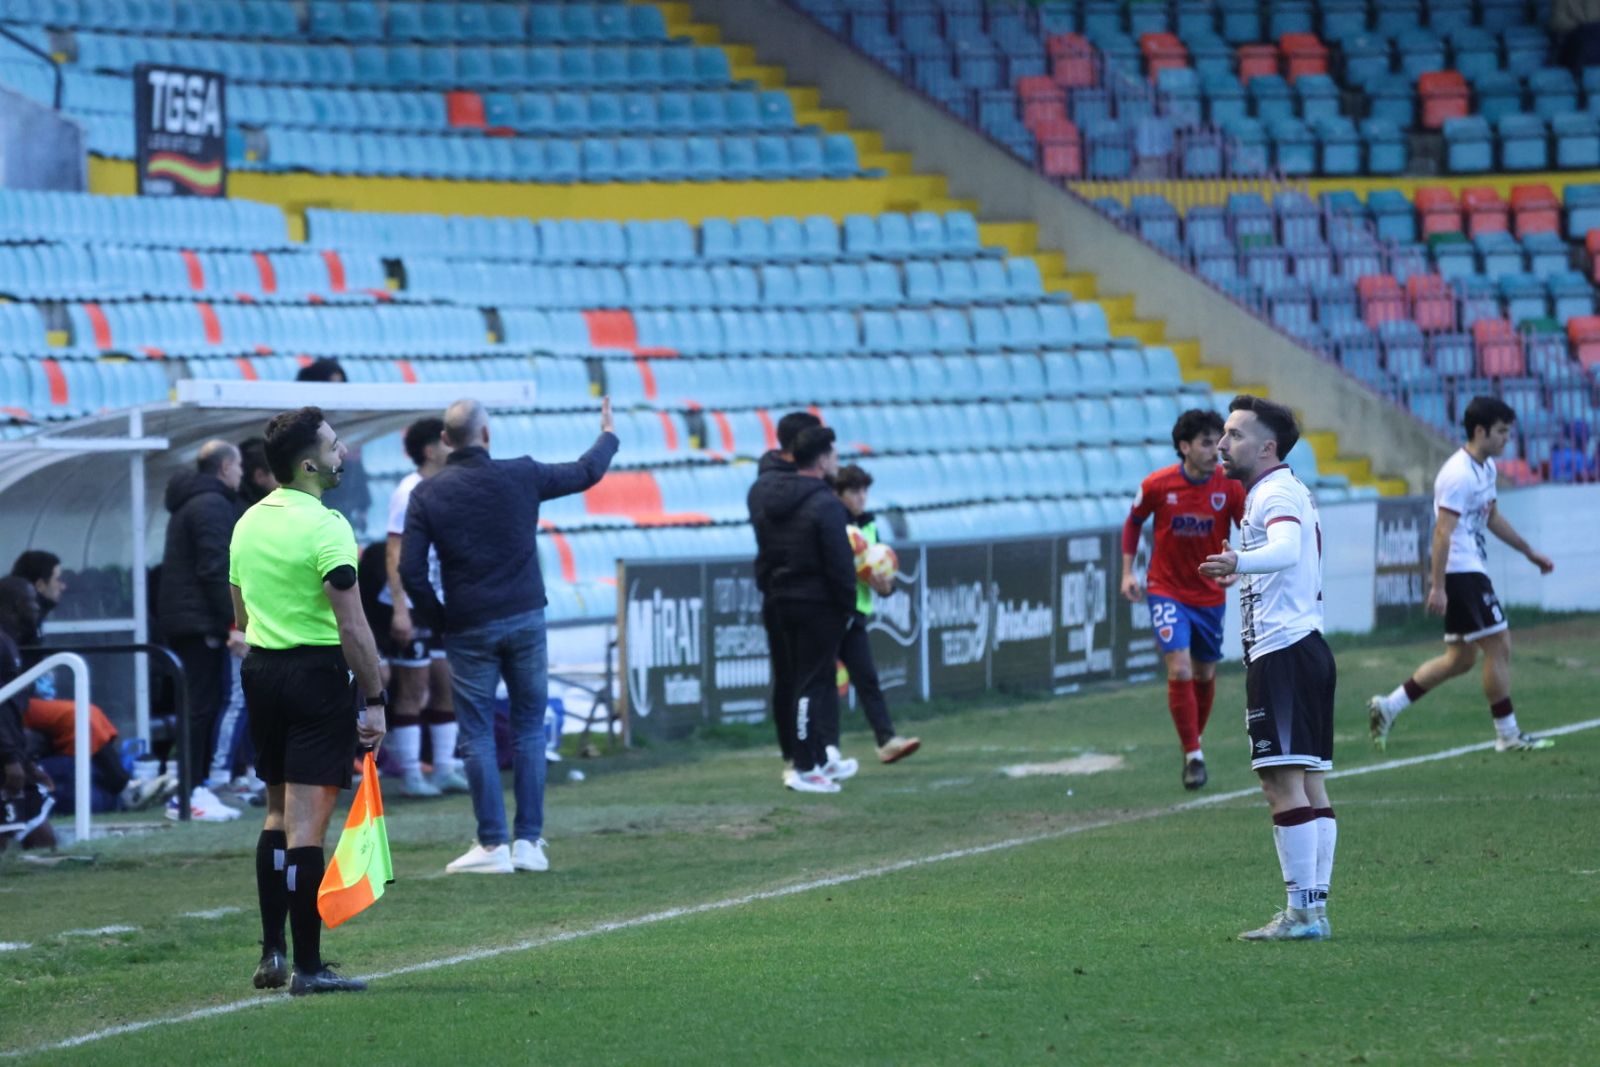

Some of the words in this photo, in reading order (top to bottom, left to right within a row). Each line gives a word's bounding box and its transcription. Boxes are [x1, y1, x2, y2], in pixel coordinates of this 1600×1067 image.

[148, 70, 222, 138] TGSA
[1153, 602, 1178, 627] 22
[5, 803, 16, 822] 3
